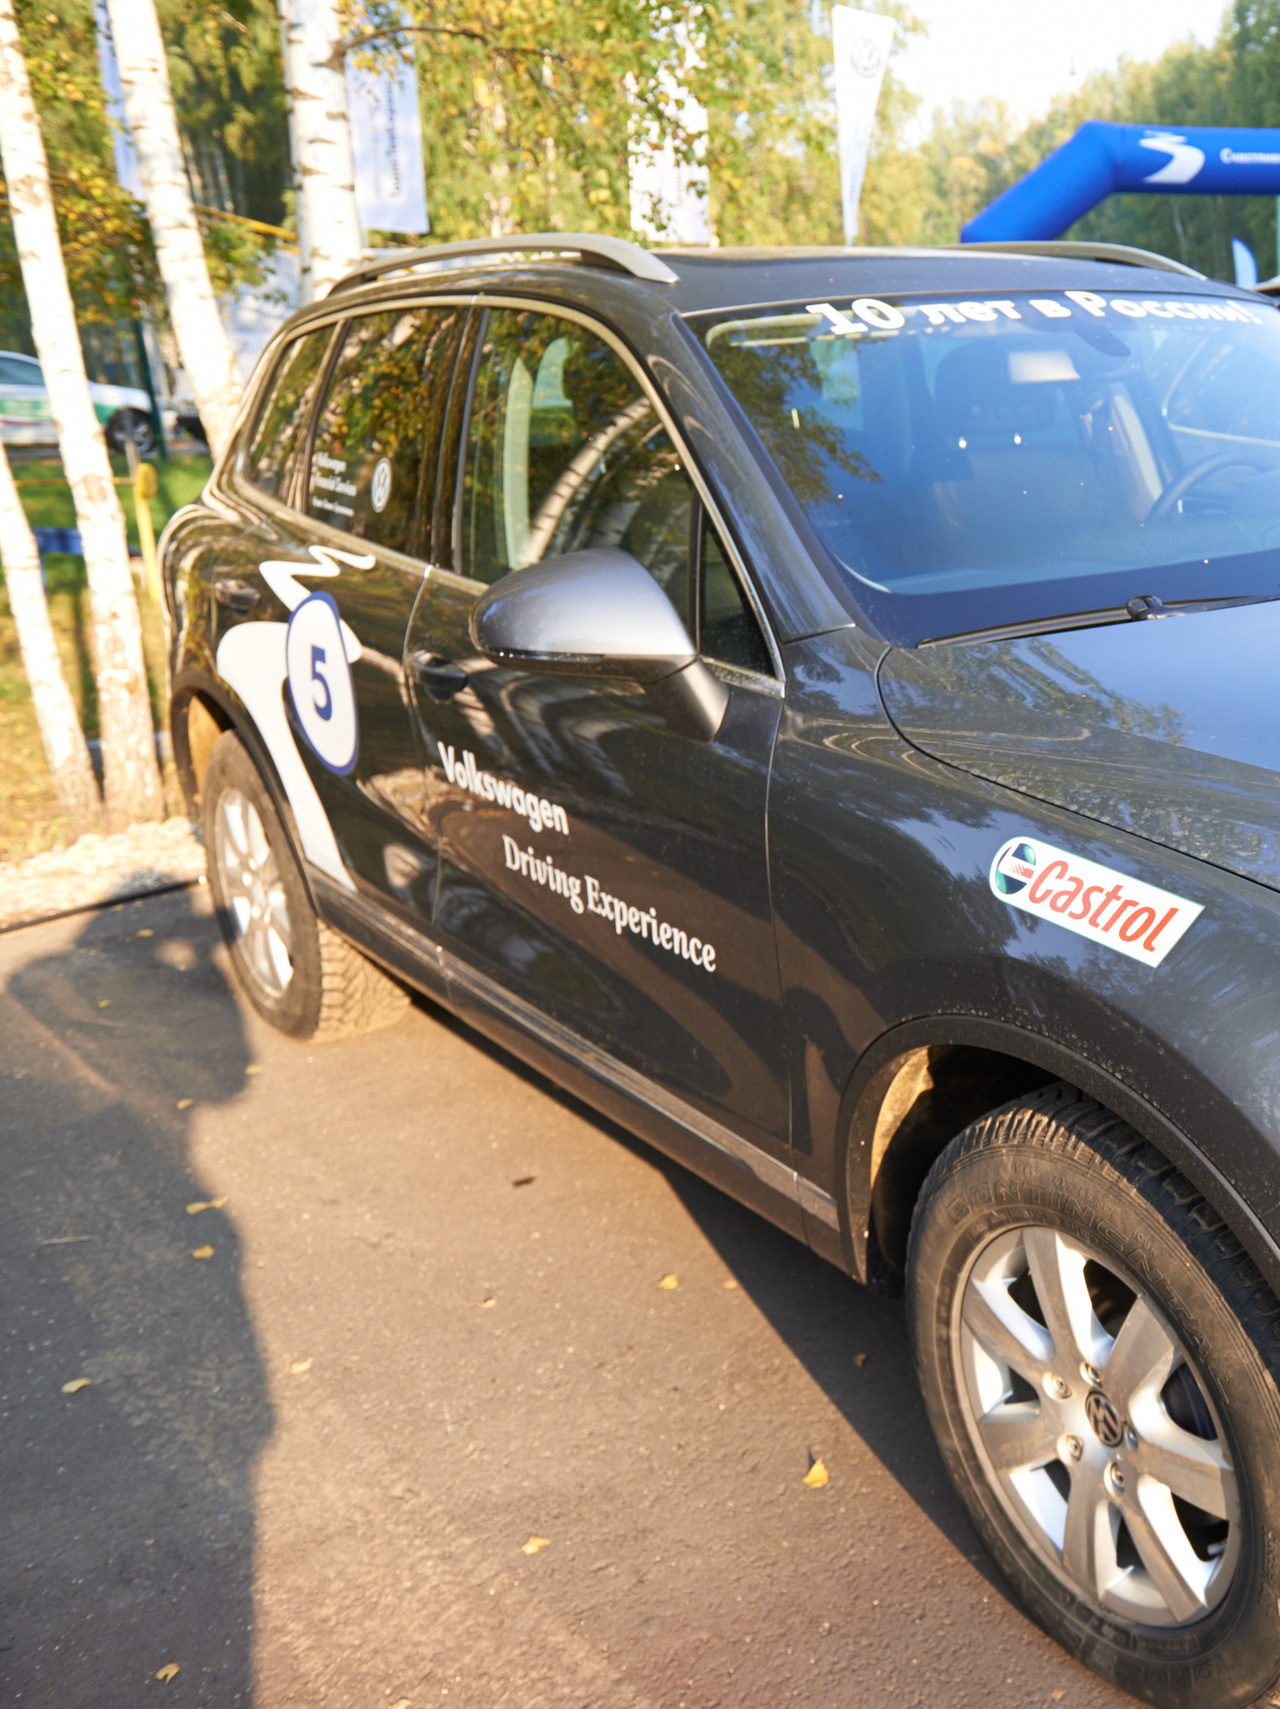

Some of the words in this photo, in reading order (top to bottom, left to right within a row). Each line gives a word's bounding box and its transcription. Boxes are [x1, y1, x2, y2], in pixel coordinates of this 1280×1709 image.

[806, 298, 905, 336] 10
[918, 300, 1022, 325] лет
[1029, 299, 1072, 318] в
[1064, 290, 1264, 324] России!
[311, 645, 332, 721] 5
[437, 741, 570, 836] Volkswagen
[502, 834, 585, 914] Driving
[584, 874, 717, 973] Experience
[1028, 860, 1180, 953] Castrol
